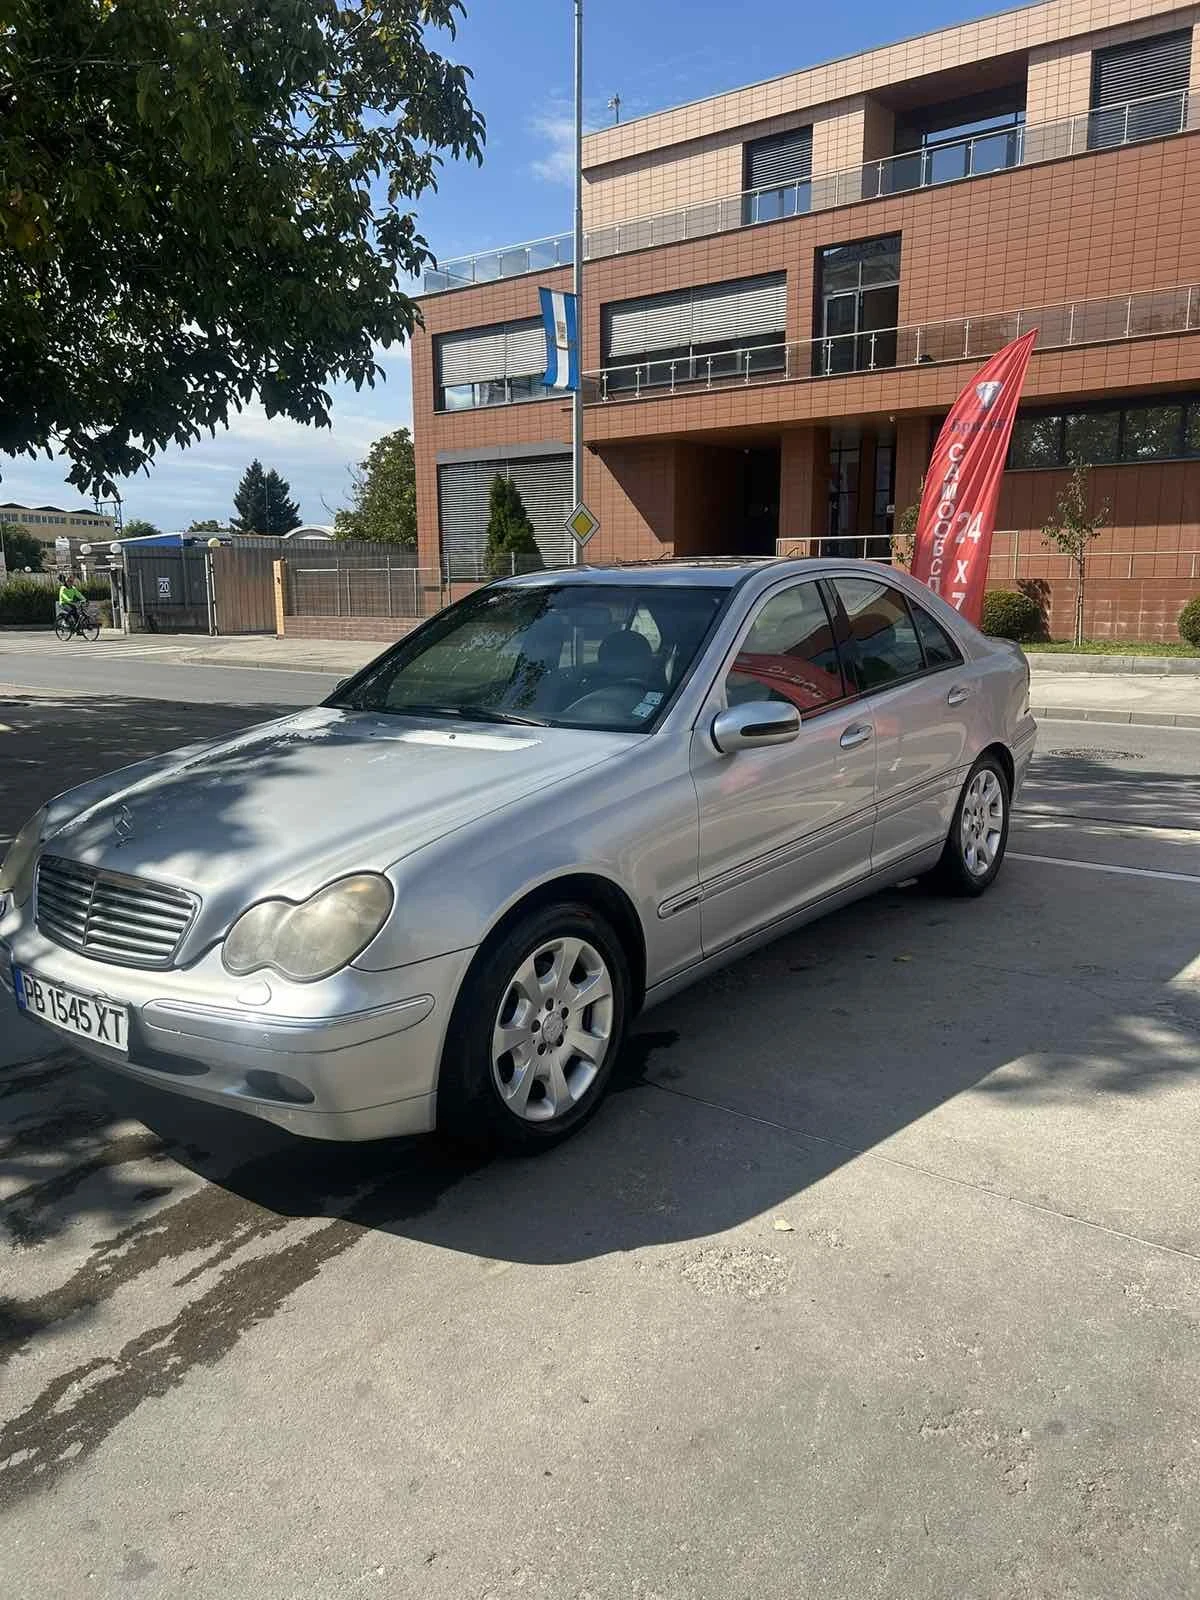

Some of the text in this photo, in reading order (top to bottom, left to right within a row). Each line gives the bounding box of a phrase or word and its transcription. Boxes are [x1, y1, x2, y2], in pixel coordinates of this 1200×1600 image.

[955, 511, 983, 544] 24
[951, 591, 966, 610] 7
[23, 975, 124, 1043] PB 1545 XT
